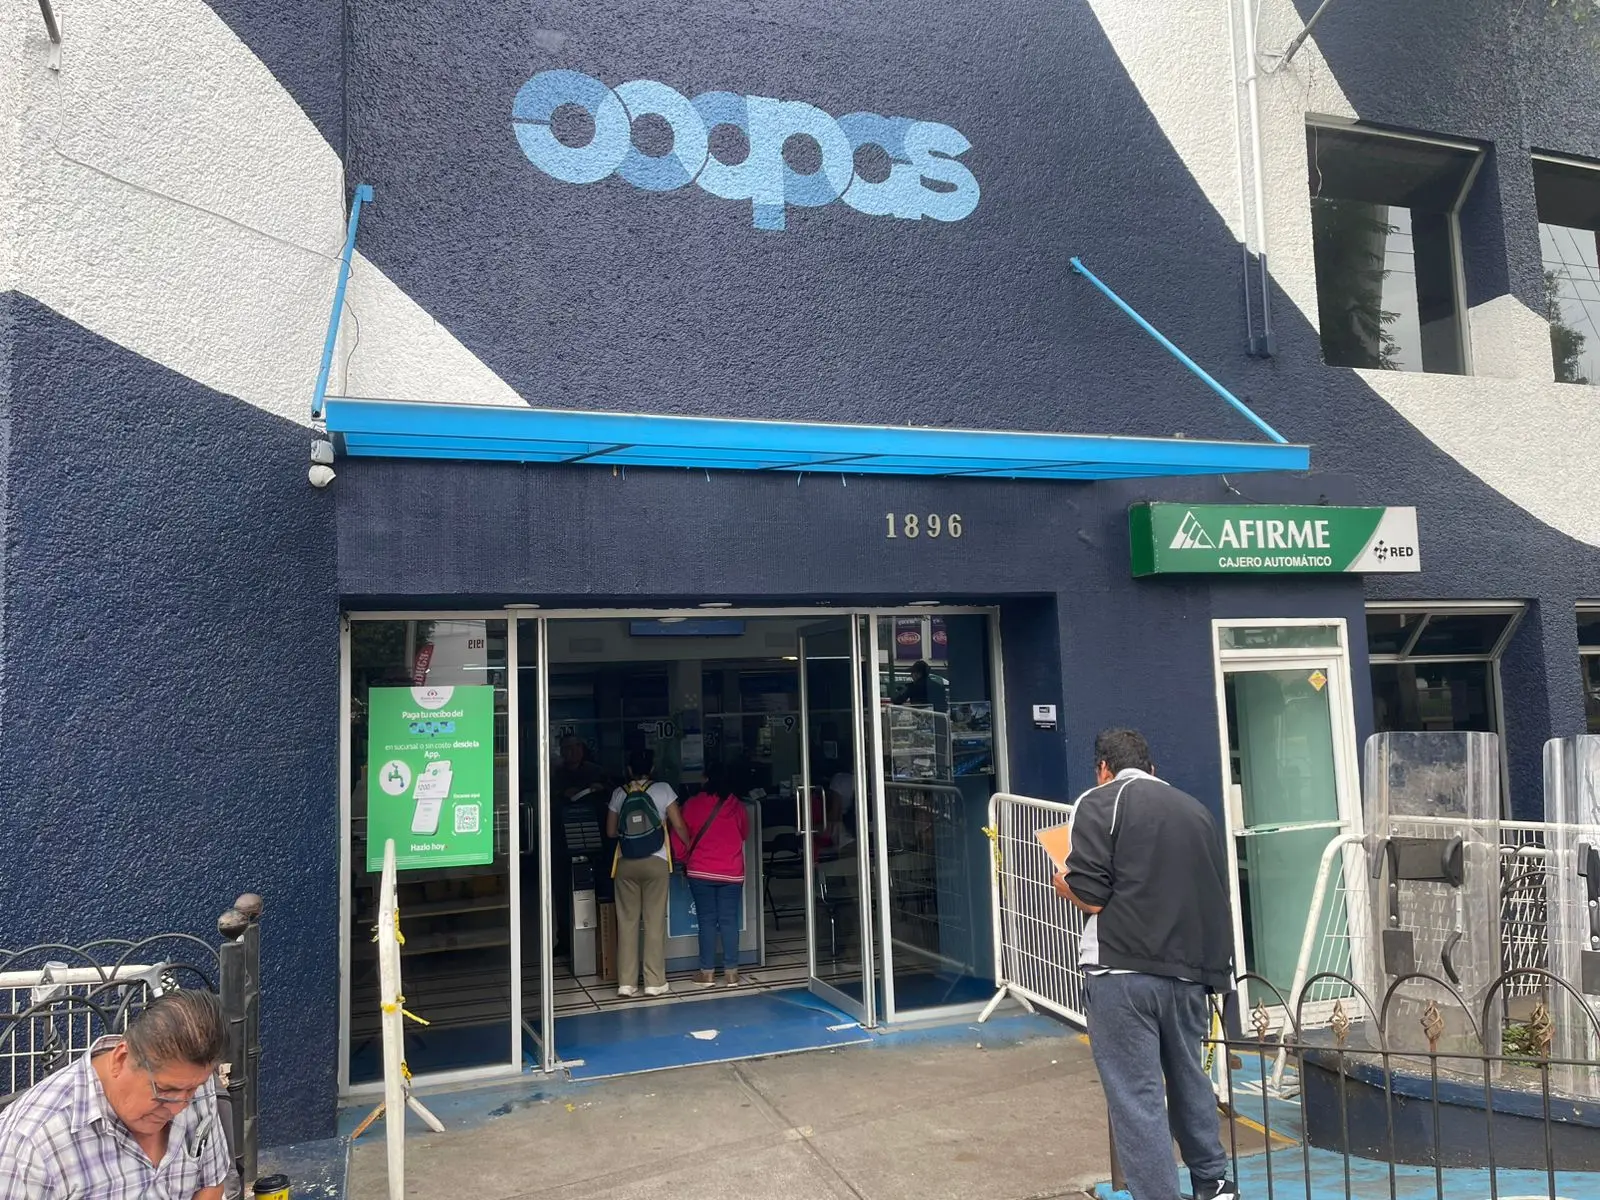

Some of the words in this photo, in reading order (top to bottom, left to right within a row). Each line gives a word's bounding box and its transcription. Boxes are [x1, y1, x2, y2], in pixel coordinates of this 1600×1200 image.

[885, 513, 962, 538] 1896
[1217, 519, 1331, 549] AFIRME
[1390, 546, 1414, 557] RED
[1218, 556, 1262, 568] CAJERO
[1264, 553, 1332, 568] AUTOMÁTICO
[402, 711, 421, 720] Paga
[429, 710, 451, 718] recibo
[451, 710, 464, 718] del
[656, 720, 675, 739] 10
[452, 740, 472, 748] desde
[472, 740, 480, 748] la
[410, 843, 431, 852] Hazlo
